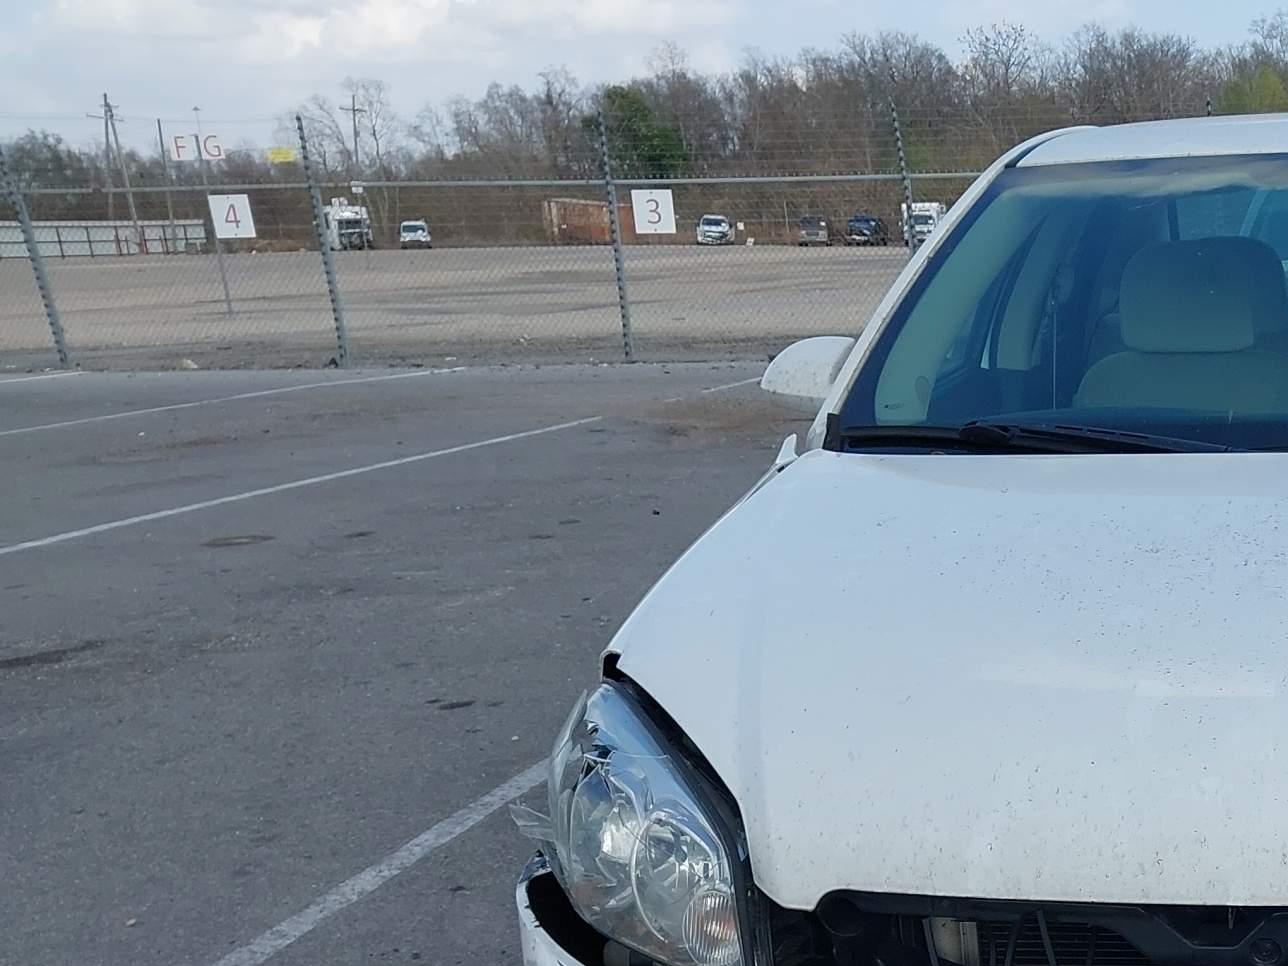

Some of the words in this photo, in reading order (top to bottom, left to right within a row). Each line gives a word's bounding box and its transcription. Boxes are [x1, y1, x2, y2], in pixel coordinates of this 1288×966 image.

[174, 136, 186, 158] F
[204, 135, 222, 157] G
[225, 204, 240, 229] 4
[646, 199, 661, 224] 3
